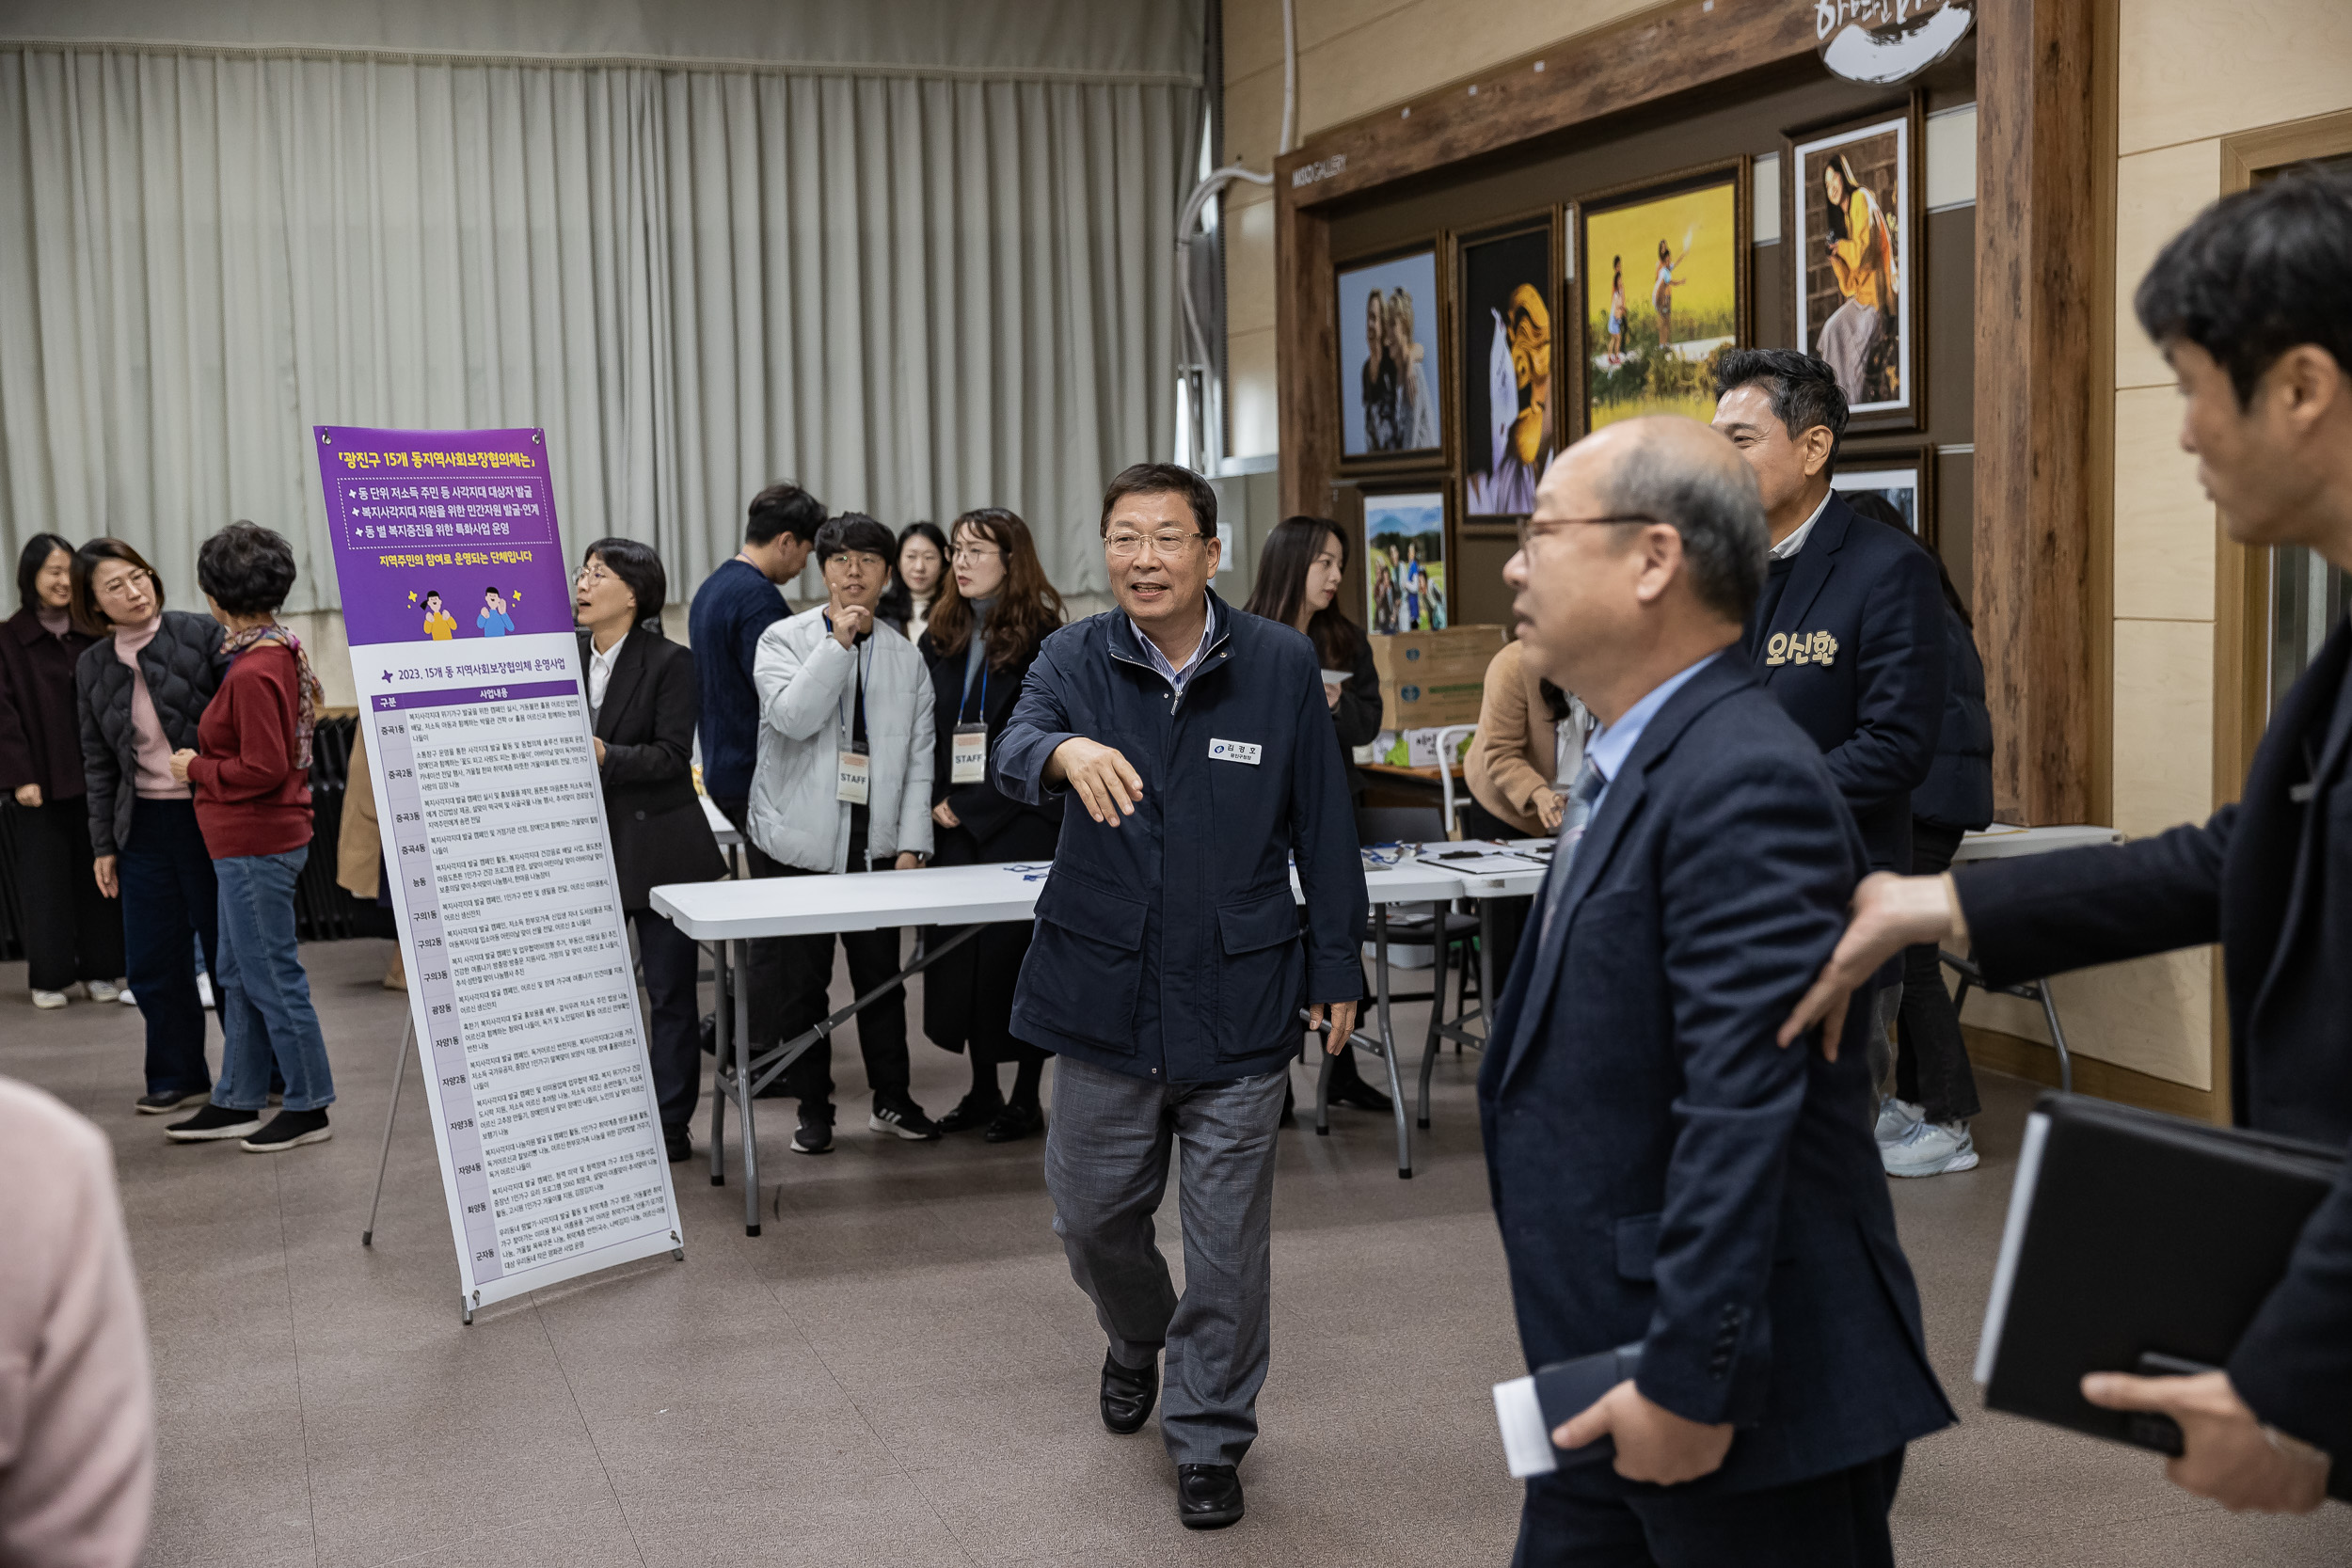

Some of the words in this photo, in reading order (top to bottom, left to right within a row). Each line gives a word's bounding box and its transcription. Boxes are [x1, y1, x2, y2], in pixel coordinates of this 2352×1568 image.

[384, 452, 408, 466] 15개
[358, 487, 367, 500] 동
[370, 487, 389, 499] 단위
[391, 486, 418, 499] 저소득
[421, 486, 438, 498] 주민
[441, 486, 449, 498] 등
[452, 486, 486, 498] 사각지대
[488, 486, 513, 498] 대상자
[515, 485, 531, 497] 발굴
[362, 505, 416, 518] 복지사각지대
[418, 505, 445, 517] 지원을
[447, 504, 464, 517] 위한
[467, 504, 501, 516] 민간자원
[365, 525, 374, 538] 동
[376, 525, 386, 537] 별
[389, 524, 432, 537] 복지증진을
[435, 523, 453, 536] 위한
[455, 523, 490, 535] 특화사업
[492, 522, 509, 534] 운영
[380, 554, 423, 566] 지역주민의
[426, 554, 451, 566] 참여로
[455, 552, 487, 564] 운영되는
[490, 551, 531, 563] 단체입니다
[1767, 631, 1837, 664] 오신환
[398, 668, 422, 679] 2023.
[425, 667, 442, 677] 15개
[445, 665, 453, 678] 동
[456, 661, 531, 675] 지역사회보장협의체
[534, 658, 564, 670] 운영사업
[380, 697, 396, 707] 구분
[480, 687, 507, 698] 사업내용
[381, 724, 404, 735] 중곡1동
[1228, 744, 1255, 754] 김경호
[955, 754, 982, 763] STAFF
[388, 768, 412, 779] 중곡2동
[841, 774, 866, 785] STAFF
[424, 797, 455, 807] 복지사각지대
[396, 811, 420, 822] 중곡3동
[430, 833, 461, 844] 복지사각지대
[401, 843, 425, 854] 중곡4동
[435, 861, 466, 871] 복지사각지대
[412, 877, 426, 887] 능동
[442, 899, 473, 910] 복지사각지대
[413, 910, 436, 921] 구의1동
[447, 926, 477, 937] 복지사각지대
[417, 937, 441, 948] 구의2동
[423, 970, 447, 981] 구의3동
[431, 1003, 451, 1014] 광장동
[435, 1036, 458, 1047] 자양1동
[442, 1074, 465, 1086] 자양2동
[450, 1118, 473, 1130] 자양3동
[458, 1162, 481, 1174] 자양4동
[467, 1202, 486, 1213] 화양동
[476, 1248, 494, 1261] 군자동
